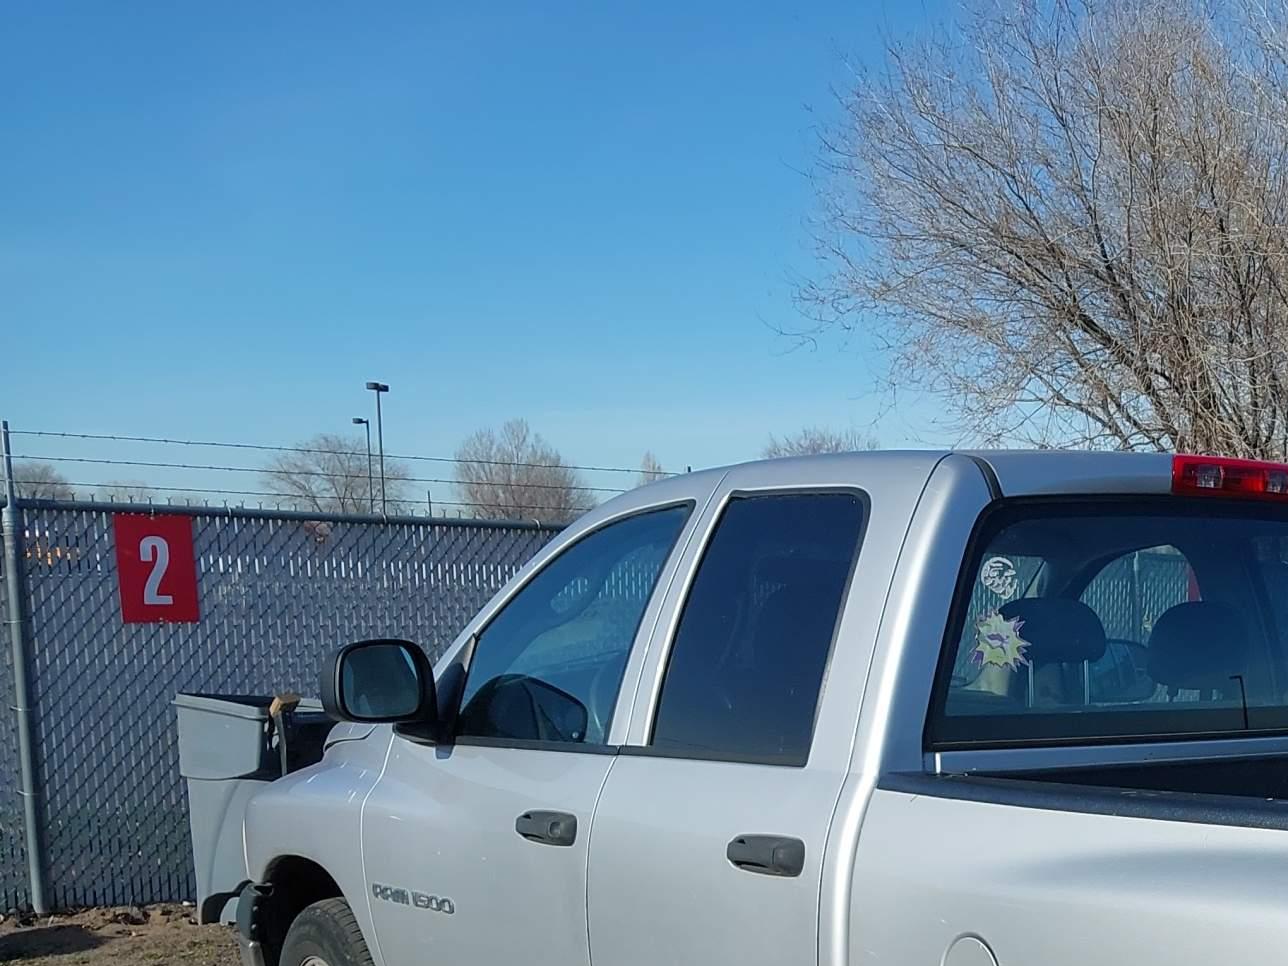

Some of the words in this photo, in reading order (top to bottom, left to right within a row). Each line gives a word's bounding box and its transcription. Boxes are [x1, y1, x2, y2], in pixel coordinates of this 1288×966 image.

[140, 536, 173, 605] 2
[372, 883, 410, 905] RAM
[411, 890, 455, 915] 1500
